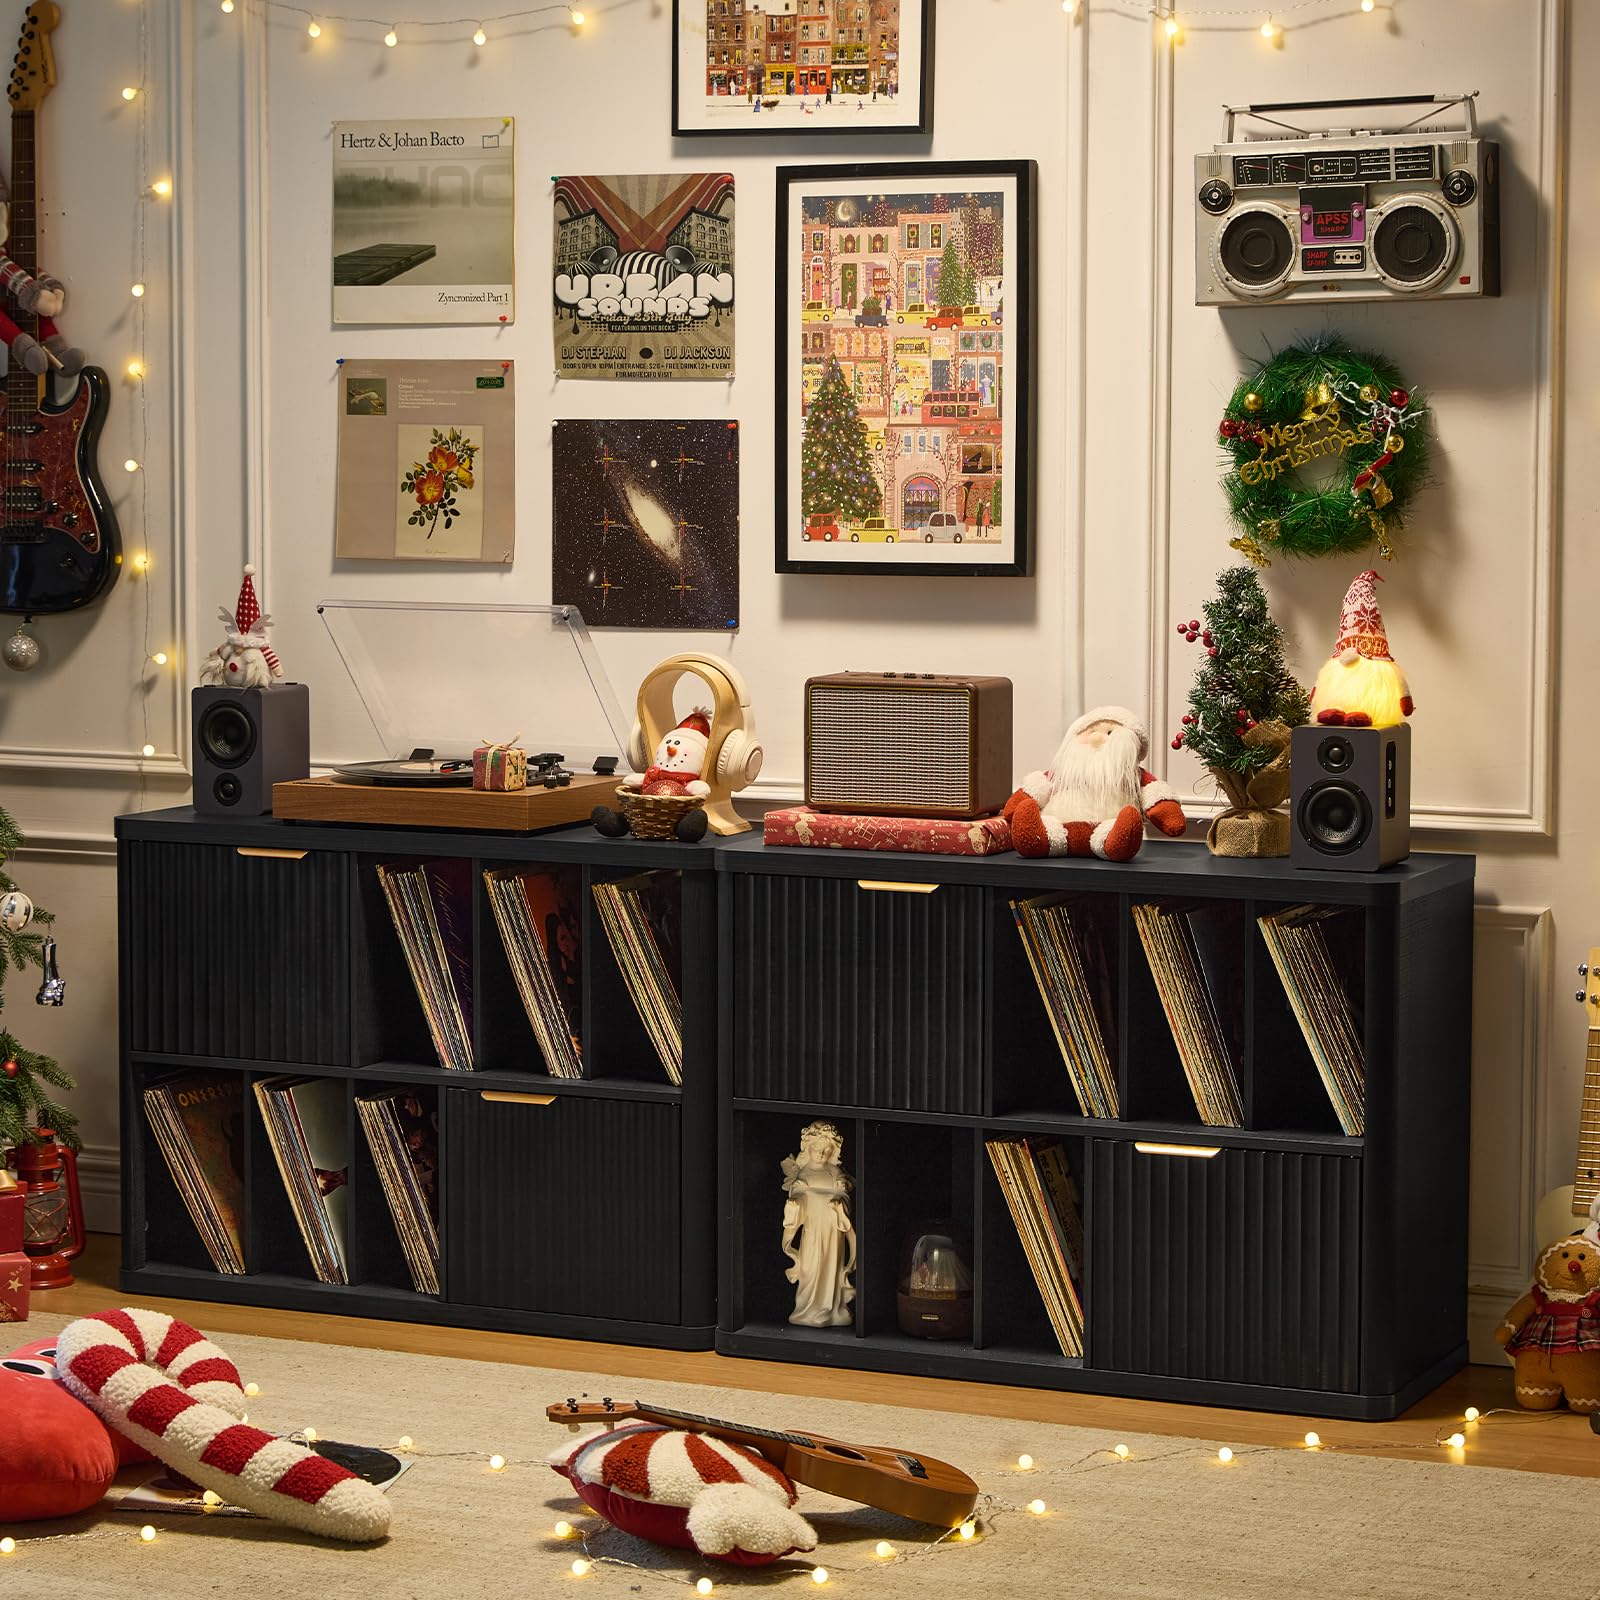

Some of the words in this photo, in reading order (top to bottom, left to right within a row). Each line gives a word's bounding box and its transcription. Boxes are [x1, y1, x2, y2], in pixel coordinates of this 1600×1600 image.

[341, 133, 376, 148] Hertz
[378, 132, 392, 148] &
[392, 132, 428, 151] Johan
[430, 131, 465, 147] Bacto
[1316, 213, 1349, 225] APSS
[1306, 251, 1328, 259] SHARP
[555, 273, 734, 304] URBAN
[438, 292, 486, 306] Zyncronized
[487, 292, 503, 302] Part
[505, 292, 509, 302] 1
[577, 297, 711, 317] SOUNDS
[590, 312, 630, 325] Friday
[665, 311, 695, 325] July
[561, 346, 575, 360] DJ
[576, 346, 627, 360] STEPHAN
[664, 346, 678, 360] DJ
[680, 346, 731, 360] JACKSON
[1260, 411, 1341, 451] Merry
[1240, 423, 1375, 484] Christmas
